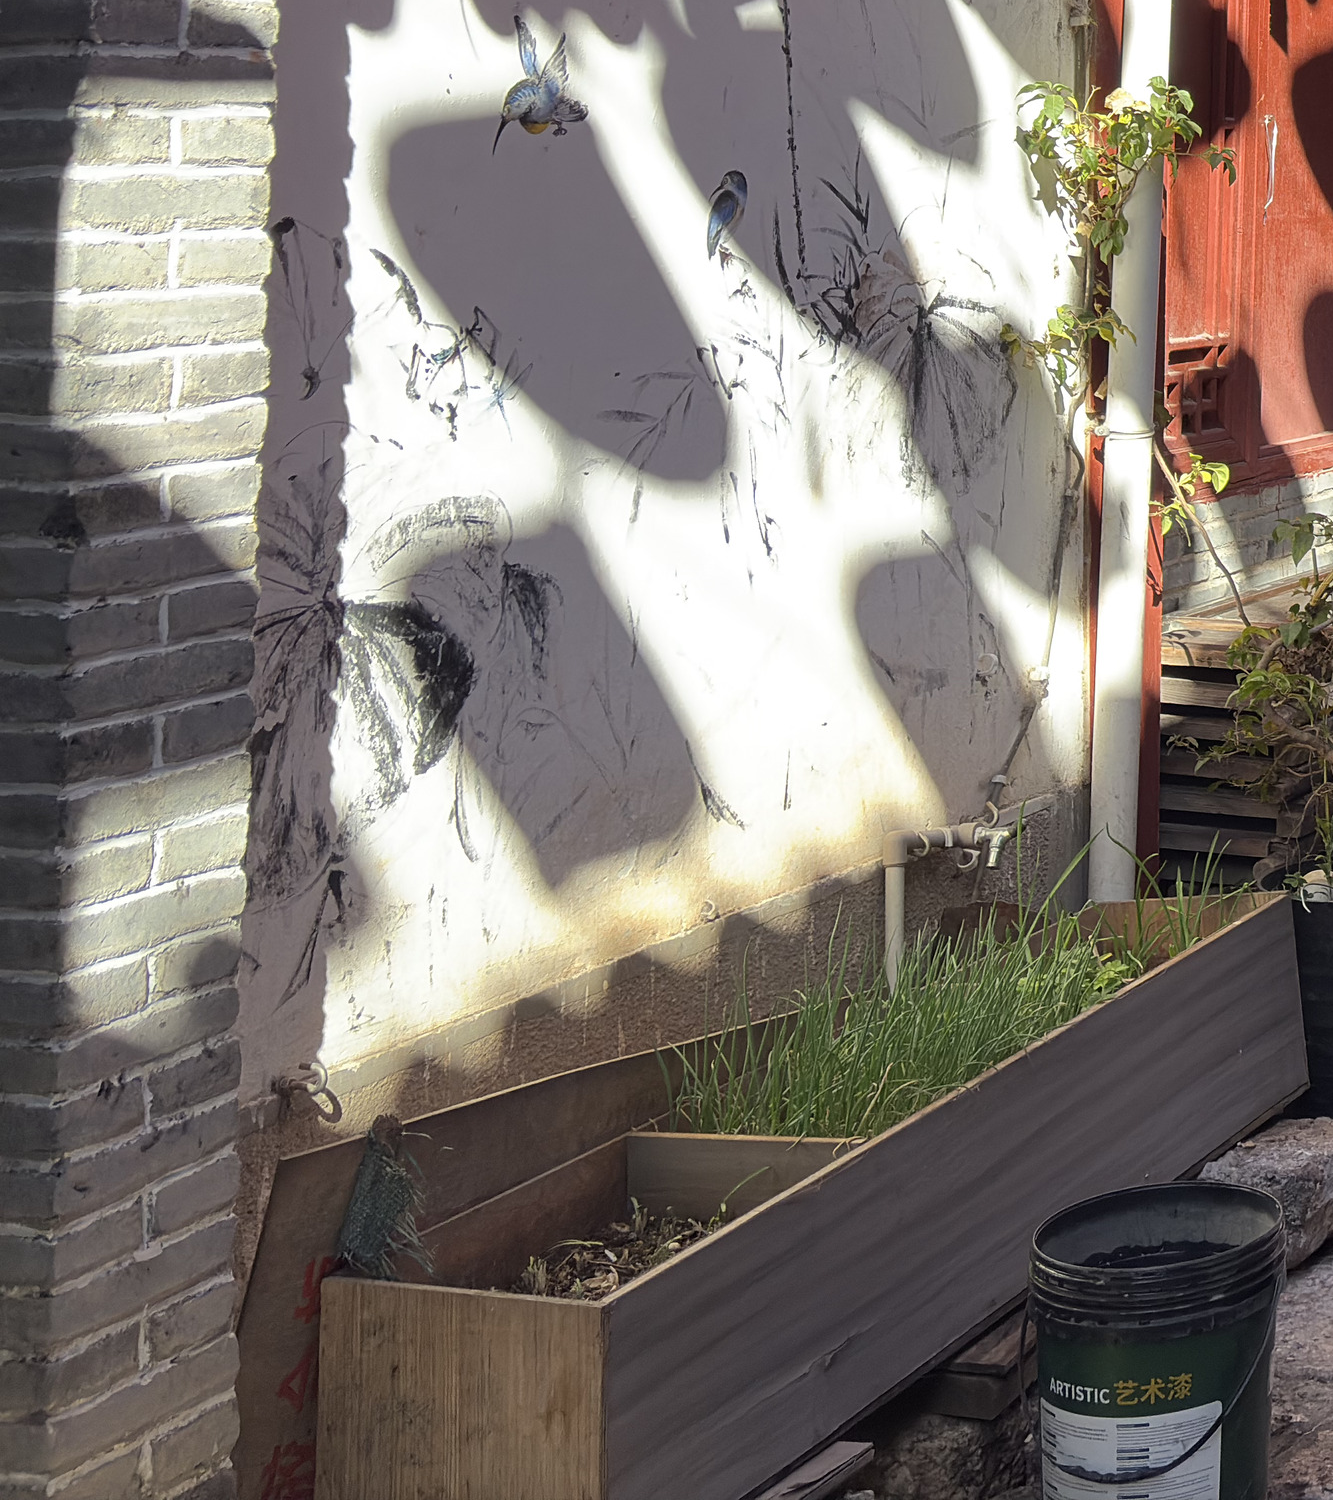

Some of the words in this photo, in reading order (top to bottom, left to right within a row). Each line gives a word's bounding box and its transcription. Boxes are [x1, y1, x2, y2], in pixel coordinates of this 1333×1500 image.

[1049, 1377, 1110, 1404] ARTISTIC
[1113, 1373, 1193, 1406] 艺术漆
